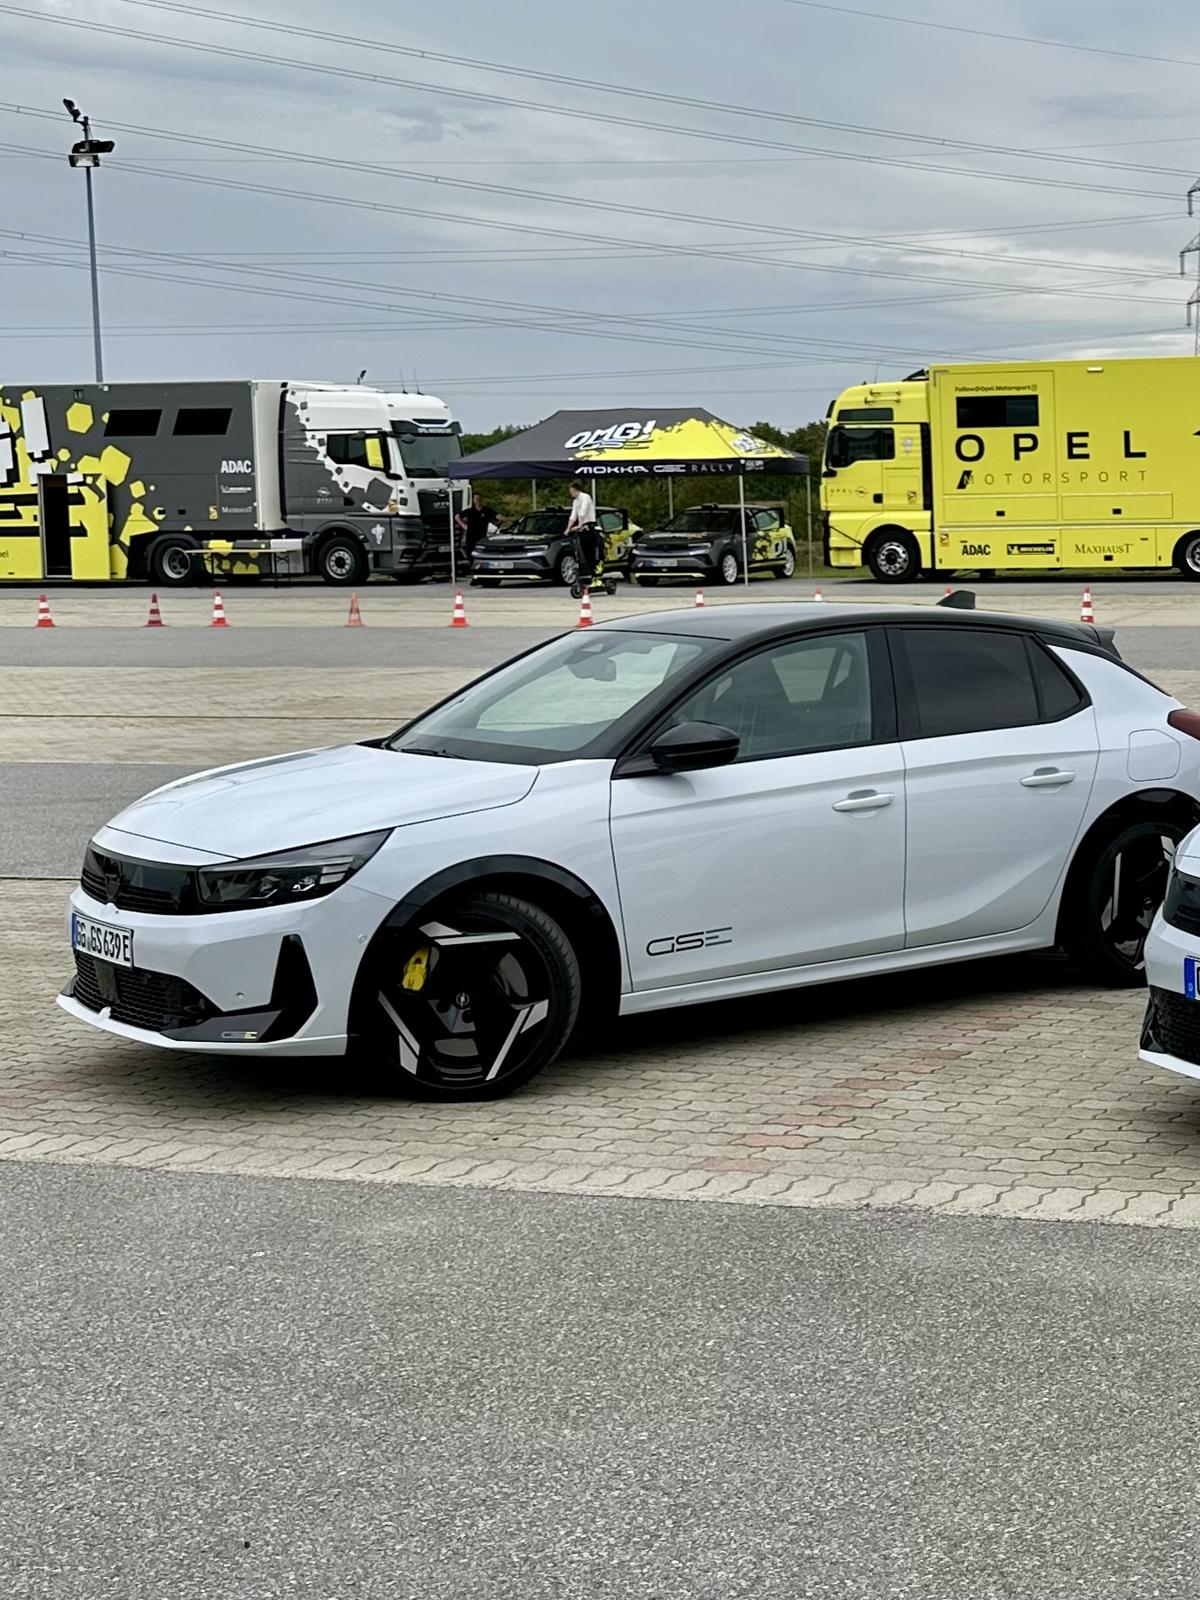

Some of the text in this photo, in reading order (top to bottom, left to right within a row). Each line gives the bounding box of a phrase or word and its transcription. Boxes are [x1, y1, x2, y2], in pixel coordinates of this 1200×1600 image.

[564, 420, 656, 449] OMG!
[955, 430, 1146, 462] OPEL
[220, 460, 252, 473] ADAC
[575, 465, 648, 474] MOKKA
[691, 464, 733, 472] RALLY
[963, 470, 1147, 486] MOTORSPORT
[961, 544, 991, 556] ADAC
[646, 926, 733, 956] GSE
